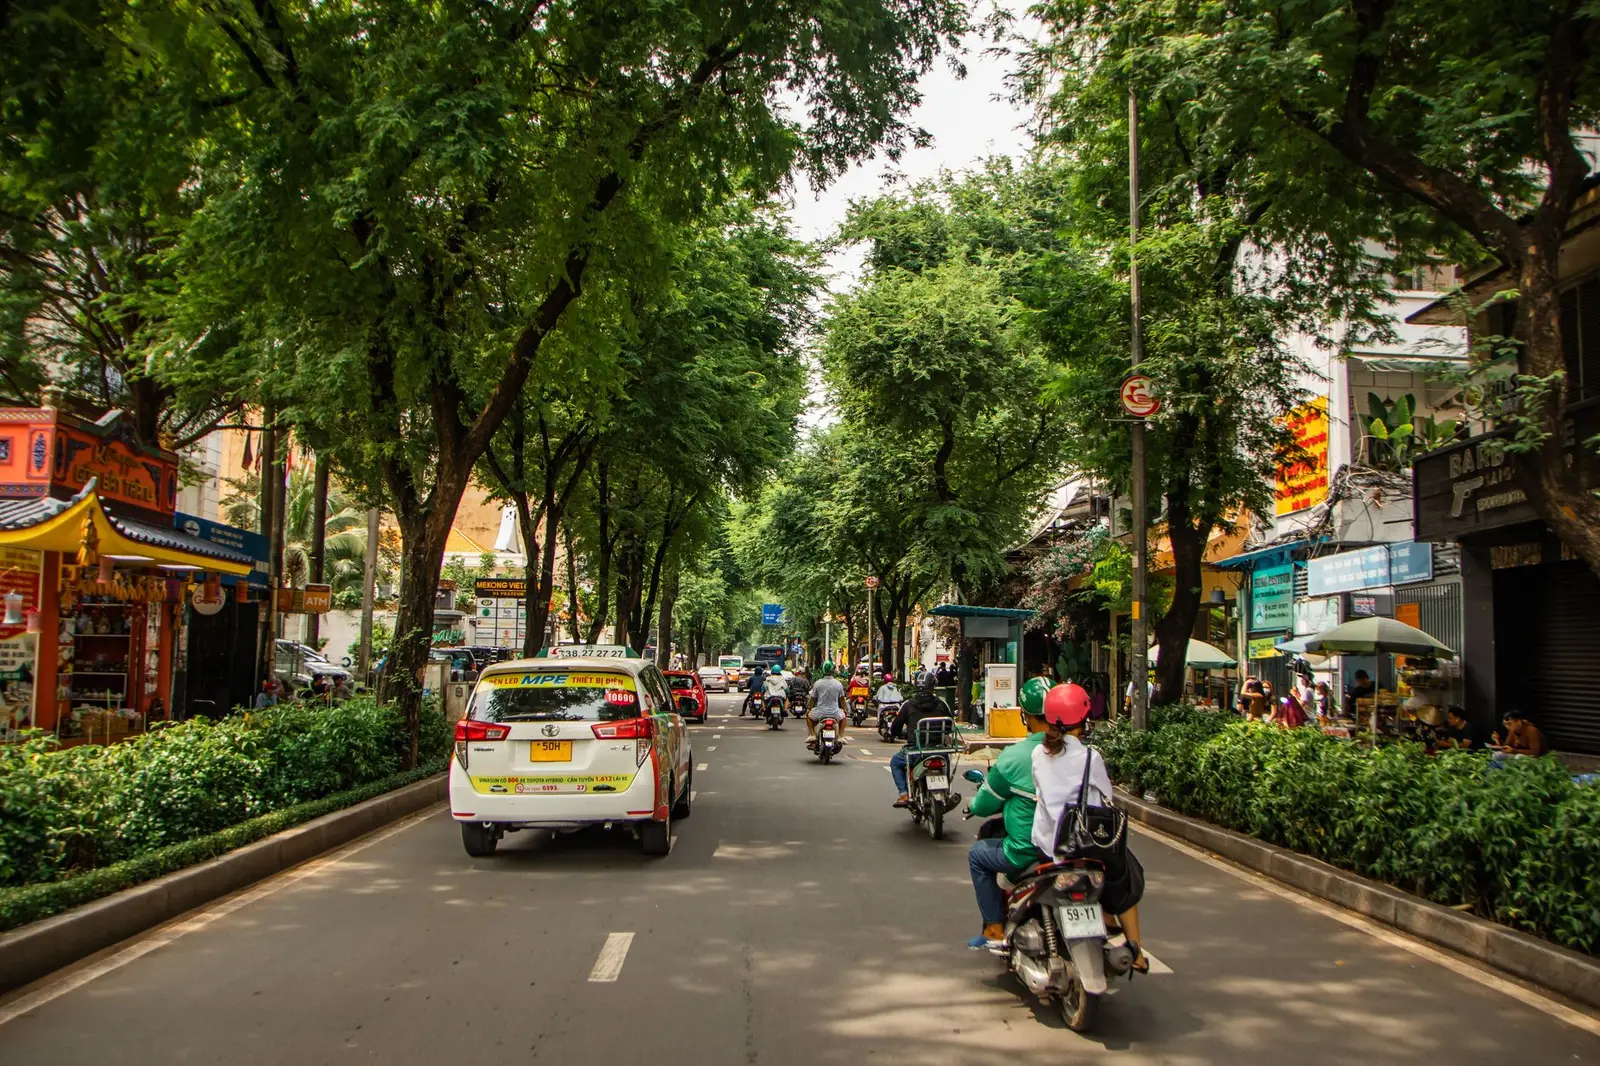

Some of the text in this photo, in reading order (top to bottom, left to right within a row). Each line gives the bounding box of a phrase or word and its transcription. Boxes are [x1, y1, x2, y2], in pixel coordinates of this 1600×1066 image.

[306, 597, 327, 606] ATM
[505, 677, 519, 685] LED
[521, 674, 570, 685] MPE
[608, 693, 634, 702] 10690
[542, 741, 560, 750] 50H
[1066, 906, 1096, 921] 59-Y1
